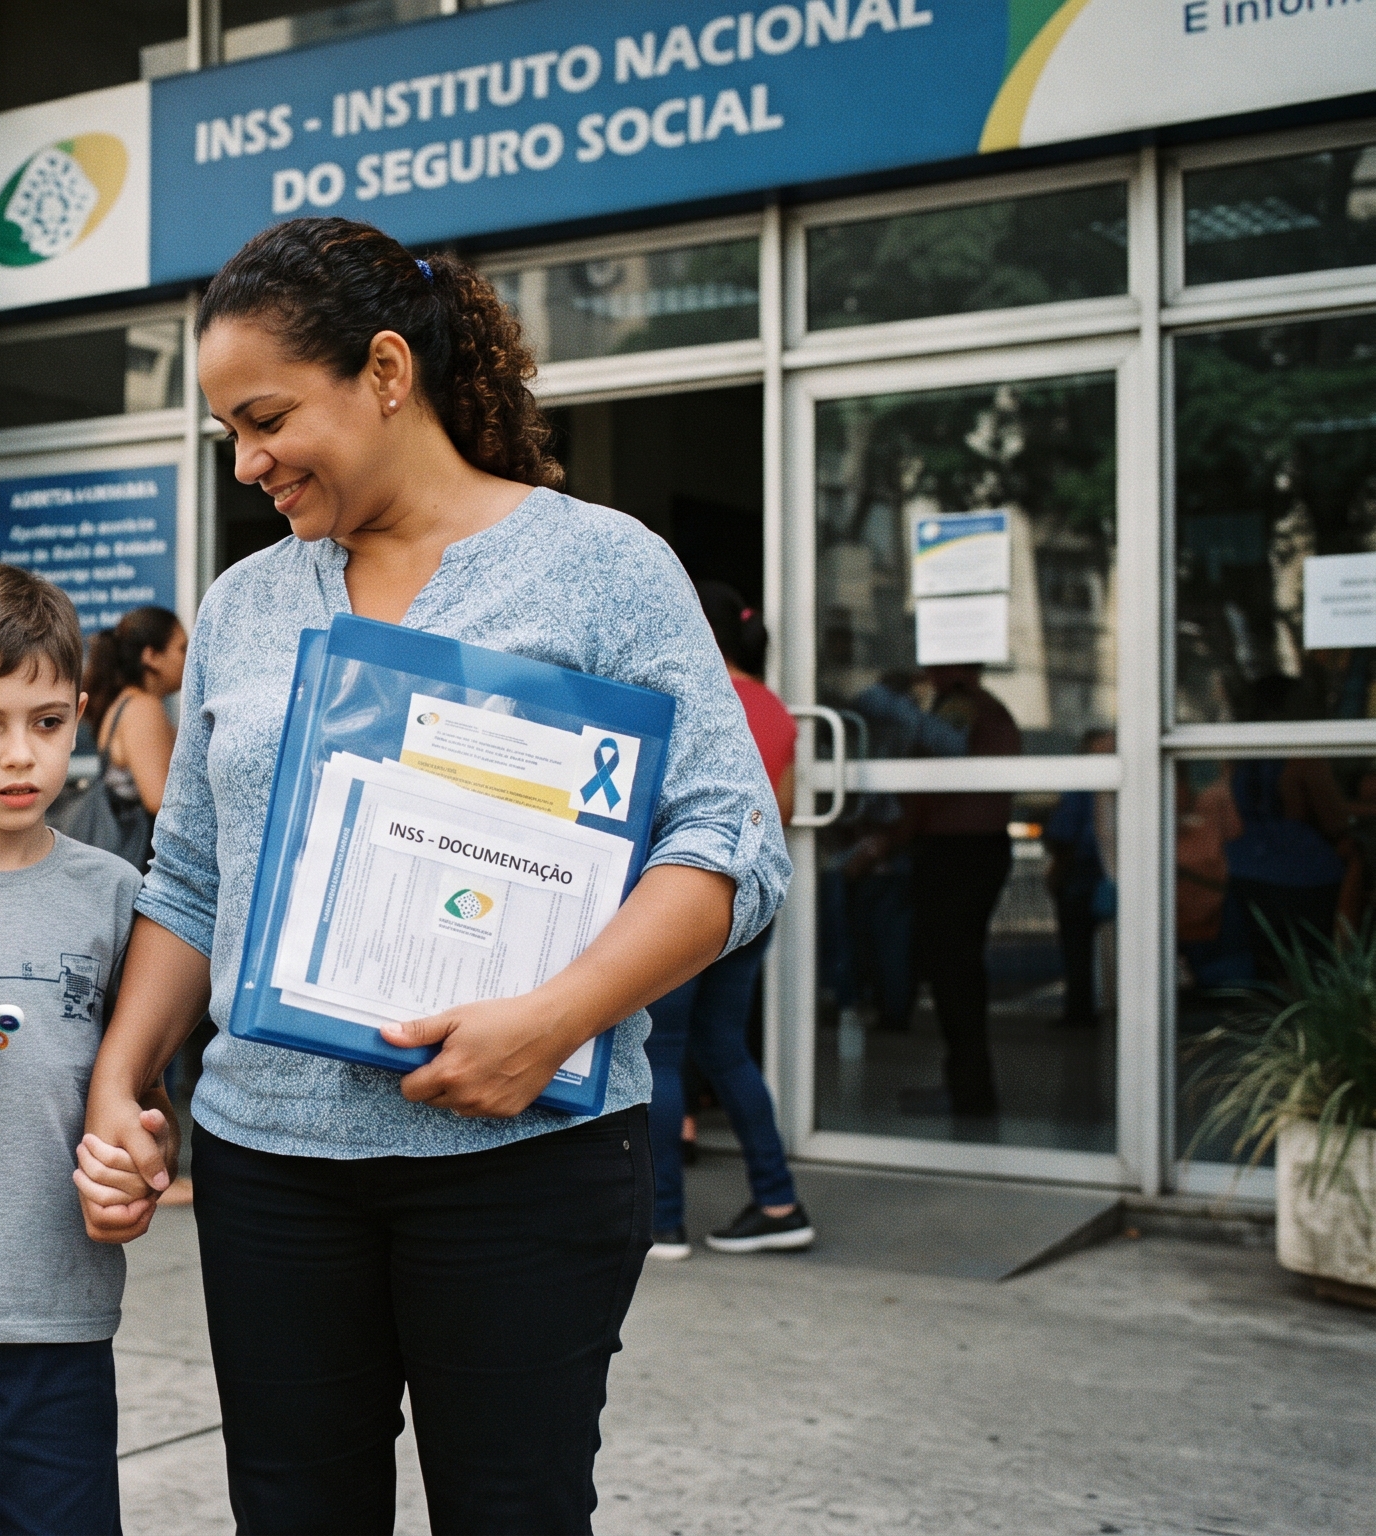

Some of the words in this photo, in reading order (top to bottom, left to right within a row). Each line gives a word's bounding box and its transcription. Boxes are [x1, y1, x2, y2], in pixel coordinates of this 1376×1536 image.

[1183, 1, 1208, 35] E
[194, 104, 293, 164] INSS
[331, 45, 602, 138] INSTITUTO
[615, 0, 933, 83] NACIONAL
[271, 161, 347, 216] DO
[354, 122, 565, 202] SEGURO
[575, 84, 784, 163] SOCIAL
[389, 821, 424, 844] INSS
